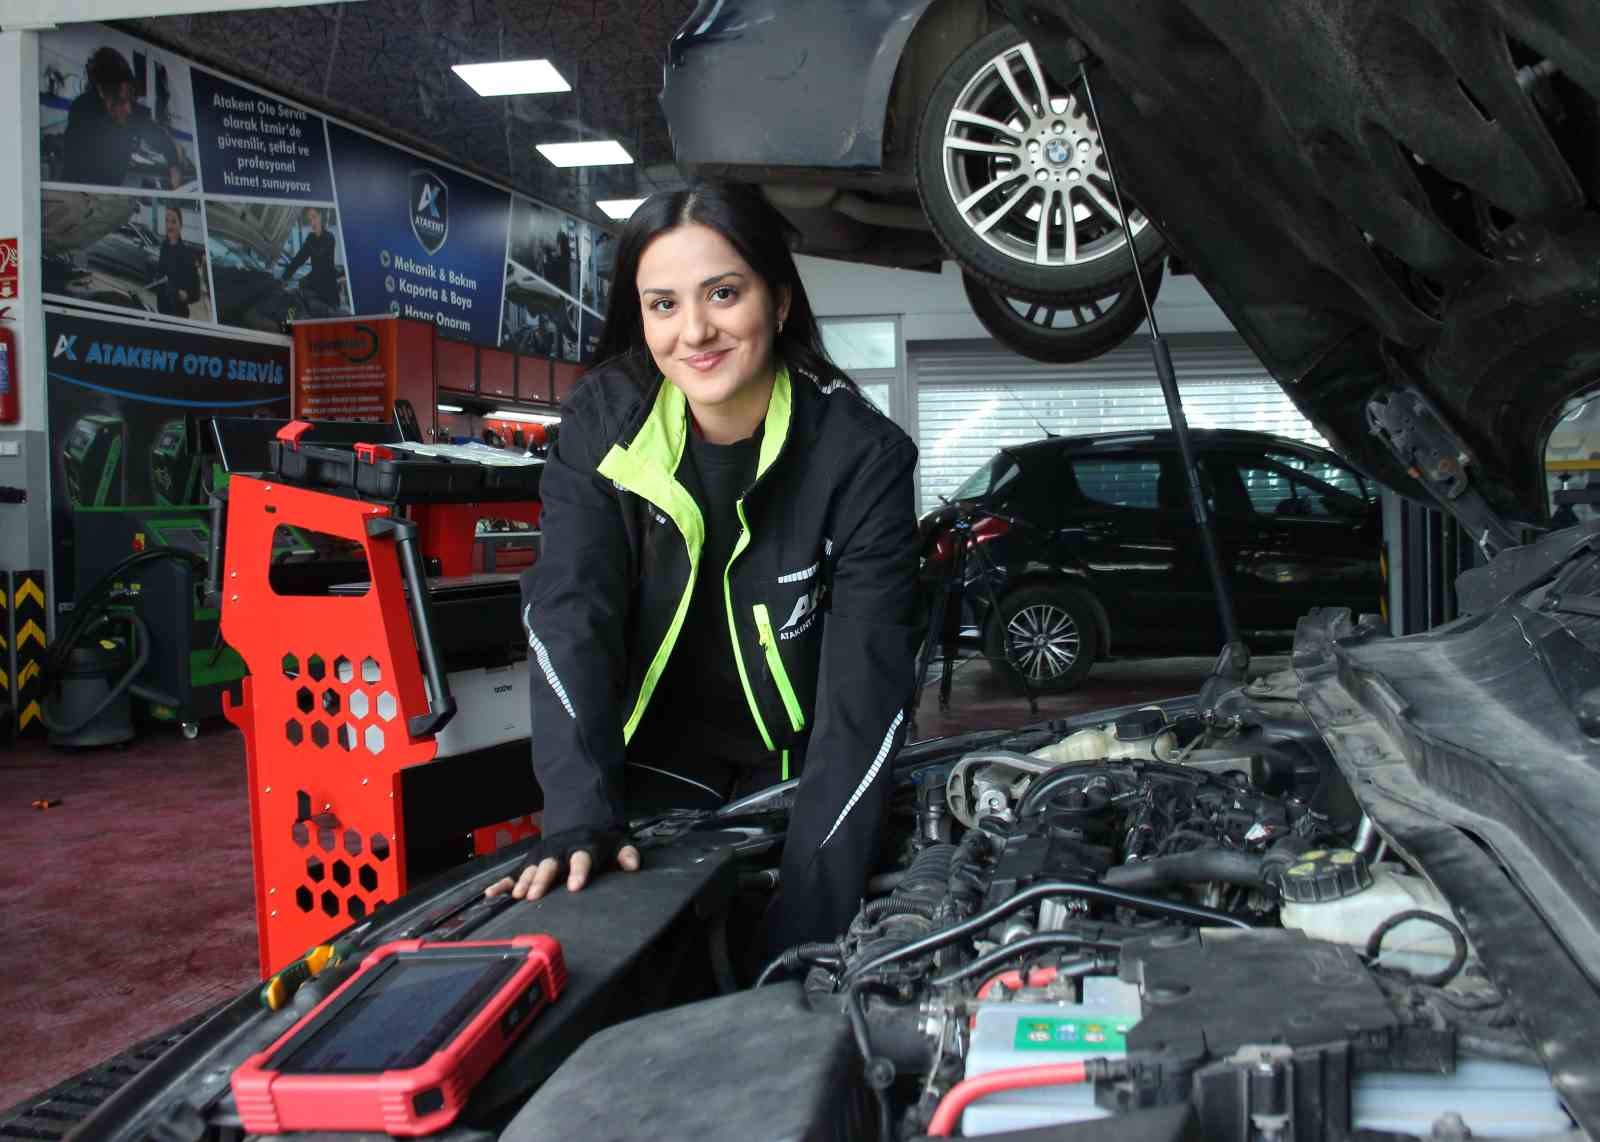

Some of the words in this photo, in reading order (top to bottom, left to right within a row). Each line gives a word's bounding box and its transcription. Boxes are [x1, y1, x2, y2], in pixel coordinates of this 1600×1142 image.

[213, 93, 255, 112] Atakent
[257, 100, 277, 116] Oto
[223, 114, 258, 132] olarak
[260, 117, 302, 138] İzmir'de
[217, 134, 266, 153] güvenilir,
[268, 140, 296, 156] şeffaf
[298, 145, 310, 157] ve
[237, 155, 296, 173] profesyonel
[223, 171, 259, 187] hizmet
[262, 178, 312, 193] sunuyoruz
[414, 215, 445, 233] ATAKENT
[394, 256, 437, 279] Mekanik
[439, 268, 446, 282] &
[449, 271, 477, 290] Bakım
[399, 279, 439, 301] Kaporta
[441, 288, 448, 302] &
[450, 292, 473, 310] Boya
[436, 312, 471, 332] Onarım
[85, 342, 180, 374] ATAKENT
[183, 353, 223, 379] OTO
[780, 619, 813, 641] ATAKENT
